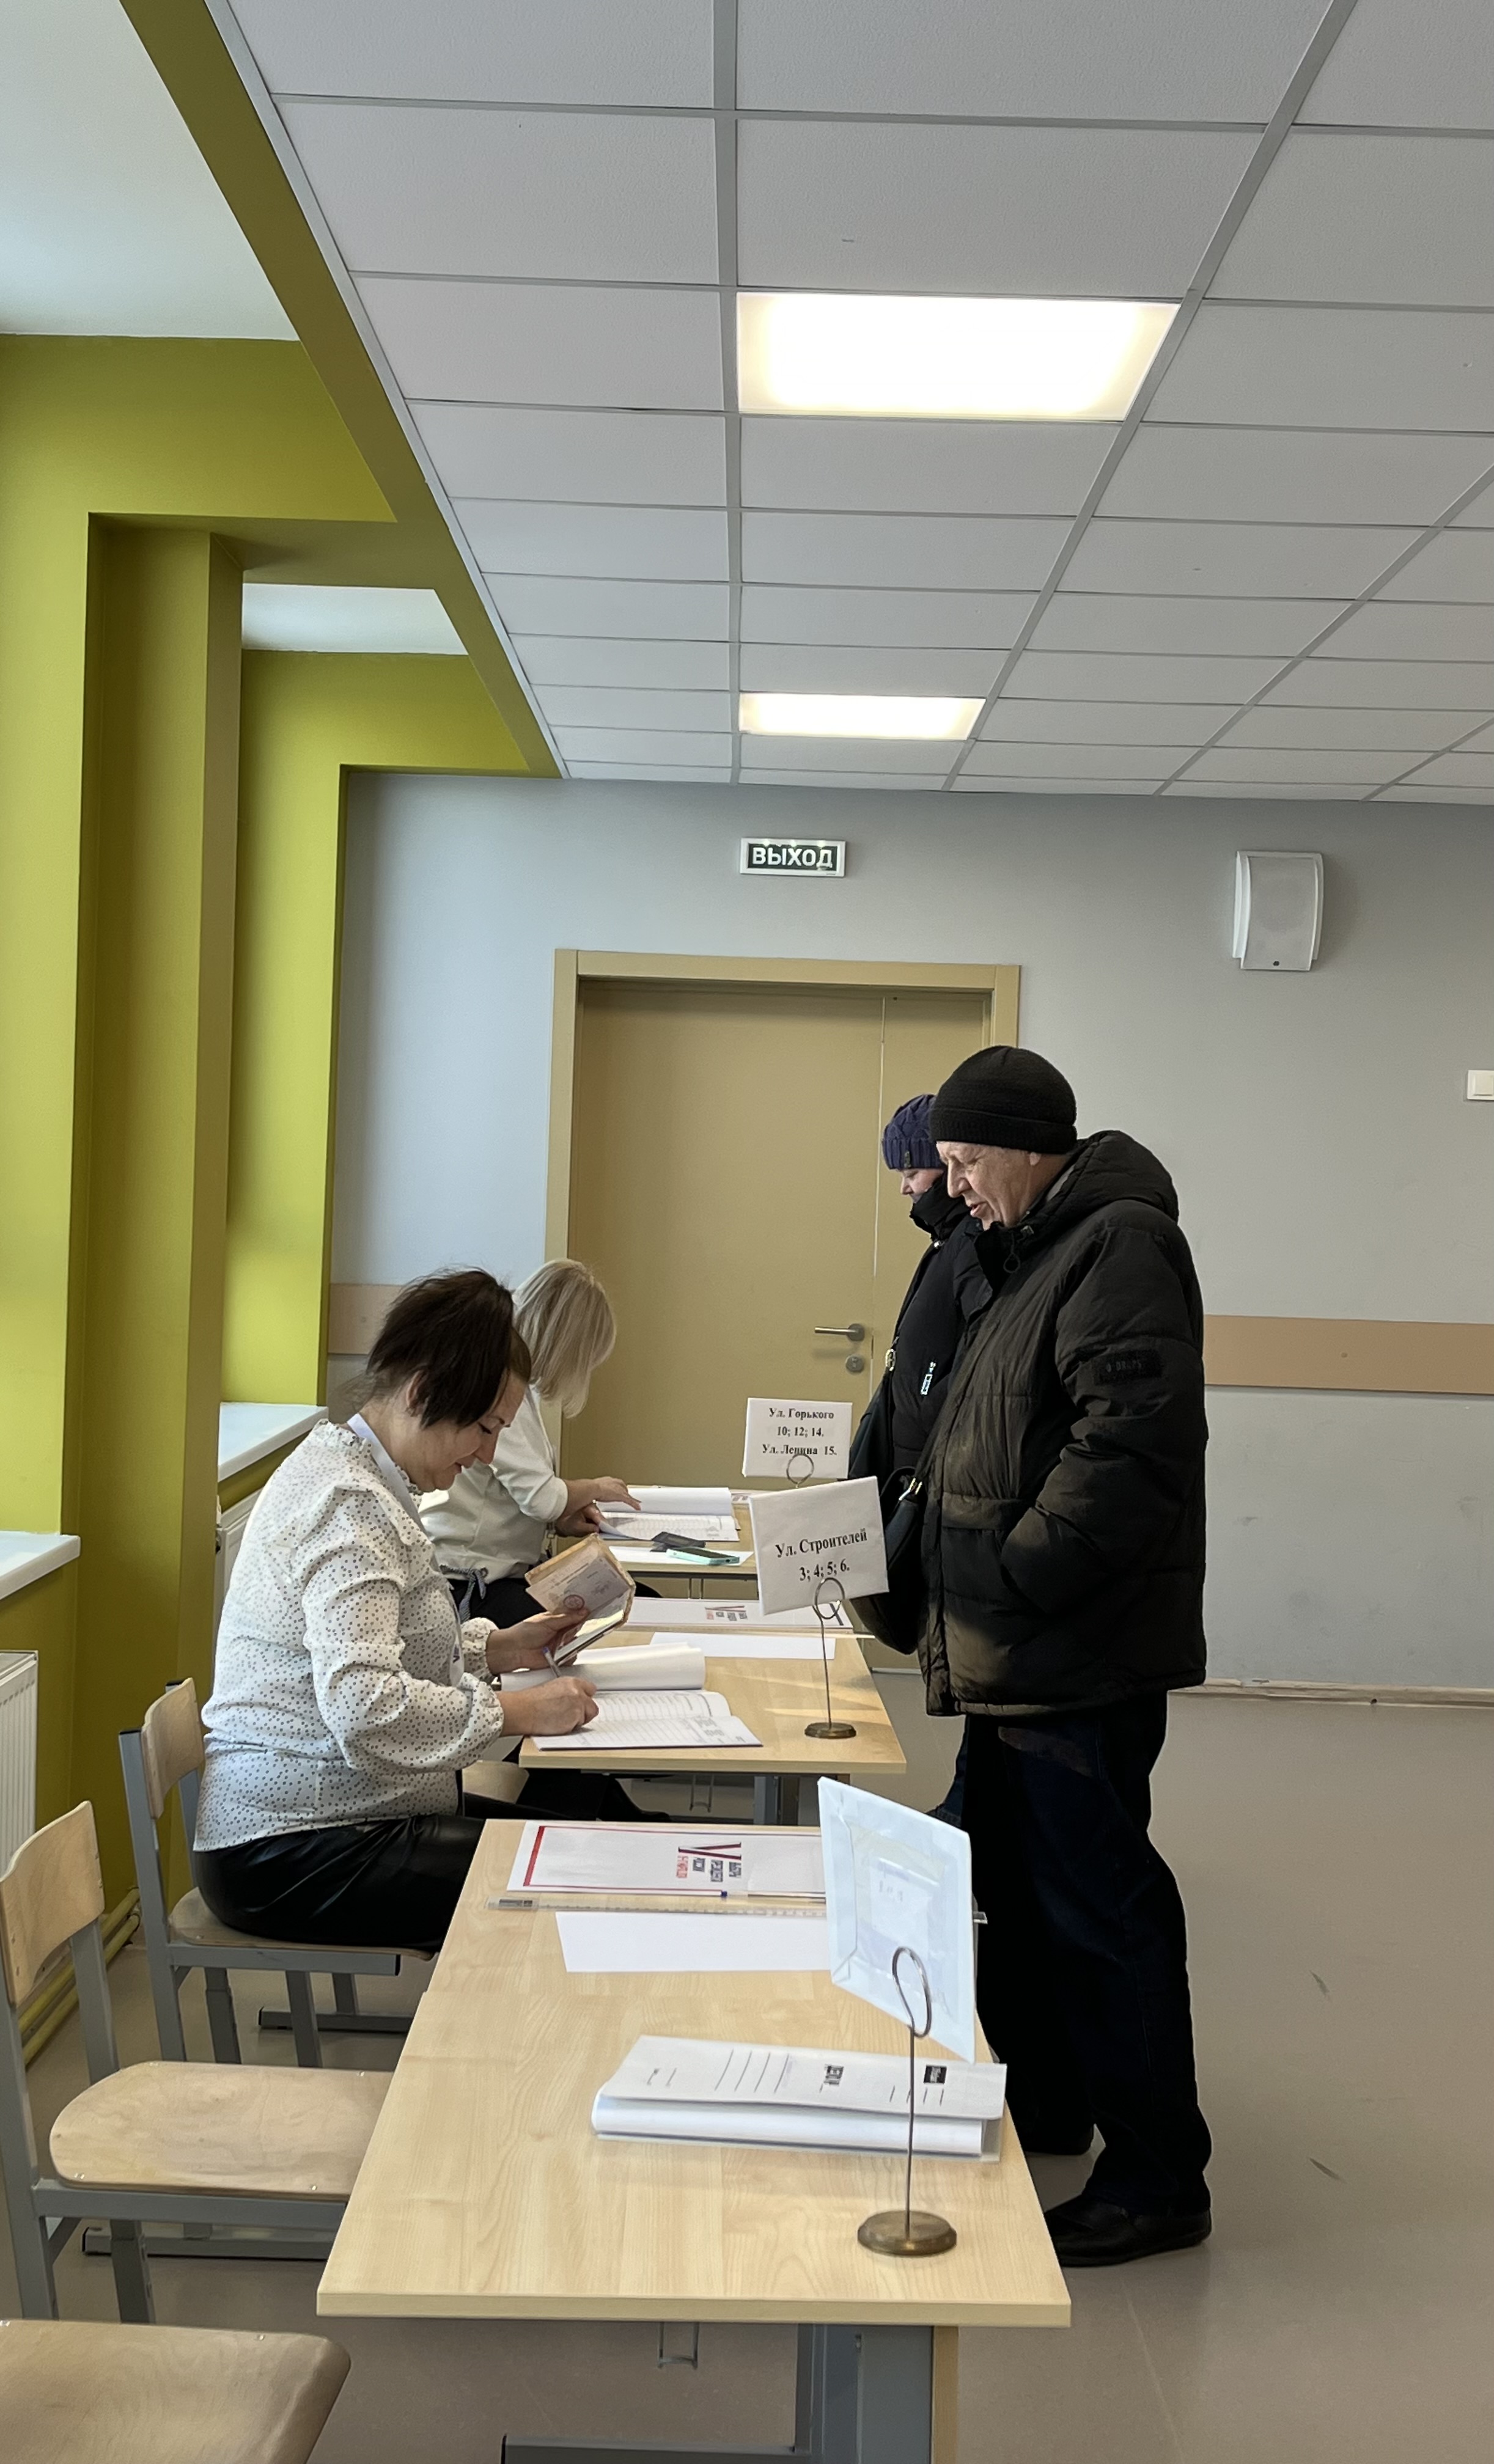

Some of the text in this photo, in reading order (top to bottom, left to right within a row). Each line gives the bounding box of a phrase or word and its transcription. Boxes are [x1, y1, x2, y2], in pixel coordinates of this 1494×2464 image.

[753, 847, 833, 868] ВЫХОД
[769, 1407, 834, 1421] Ул. Горького
[778, 1426, 824, 1438] 10; 12; 14.
[762, 1443, 837, 1455] Ул. Ленина 15.
[775, 1527, 867, 1558] Ул. Строителей
[800, 1558, 850, 1582] 3; 4; 5; 6.
